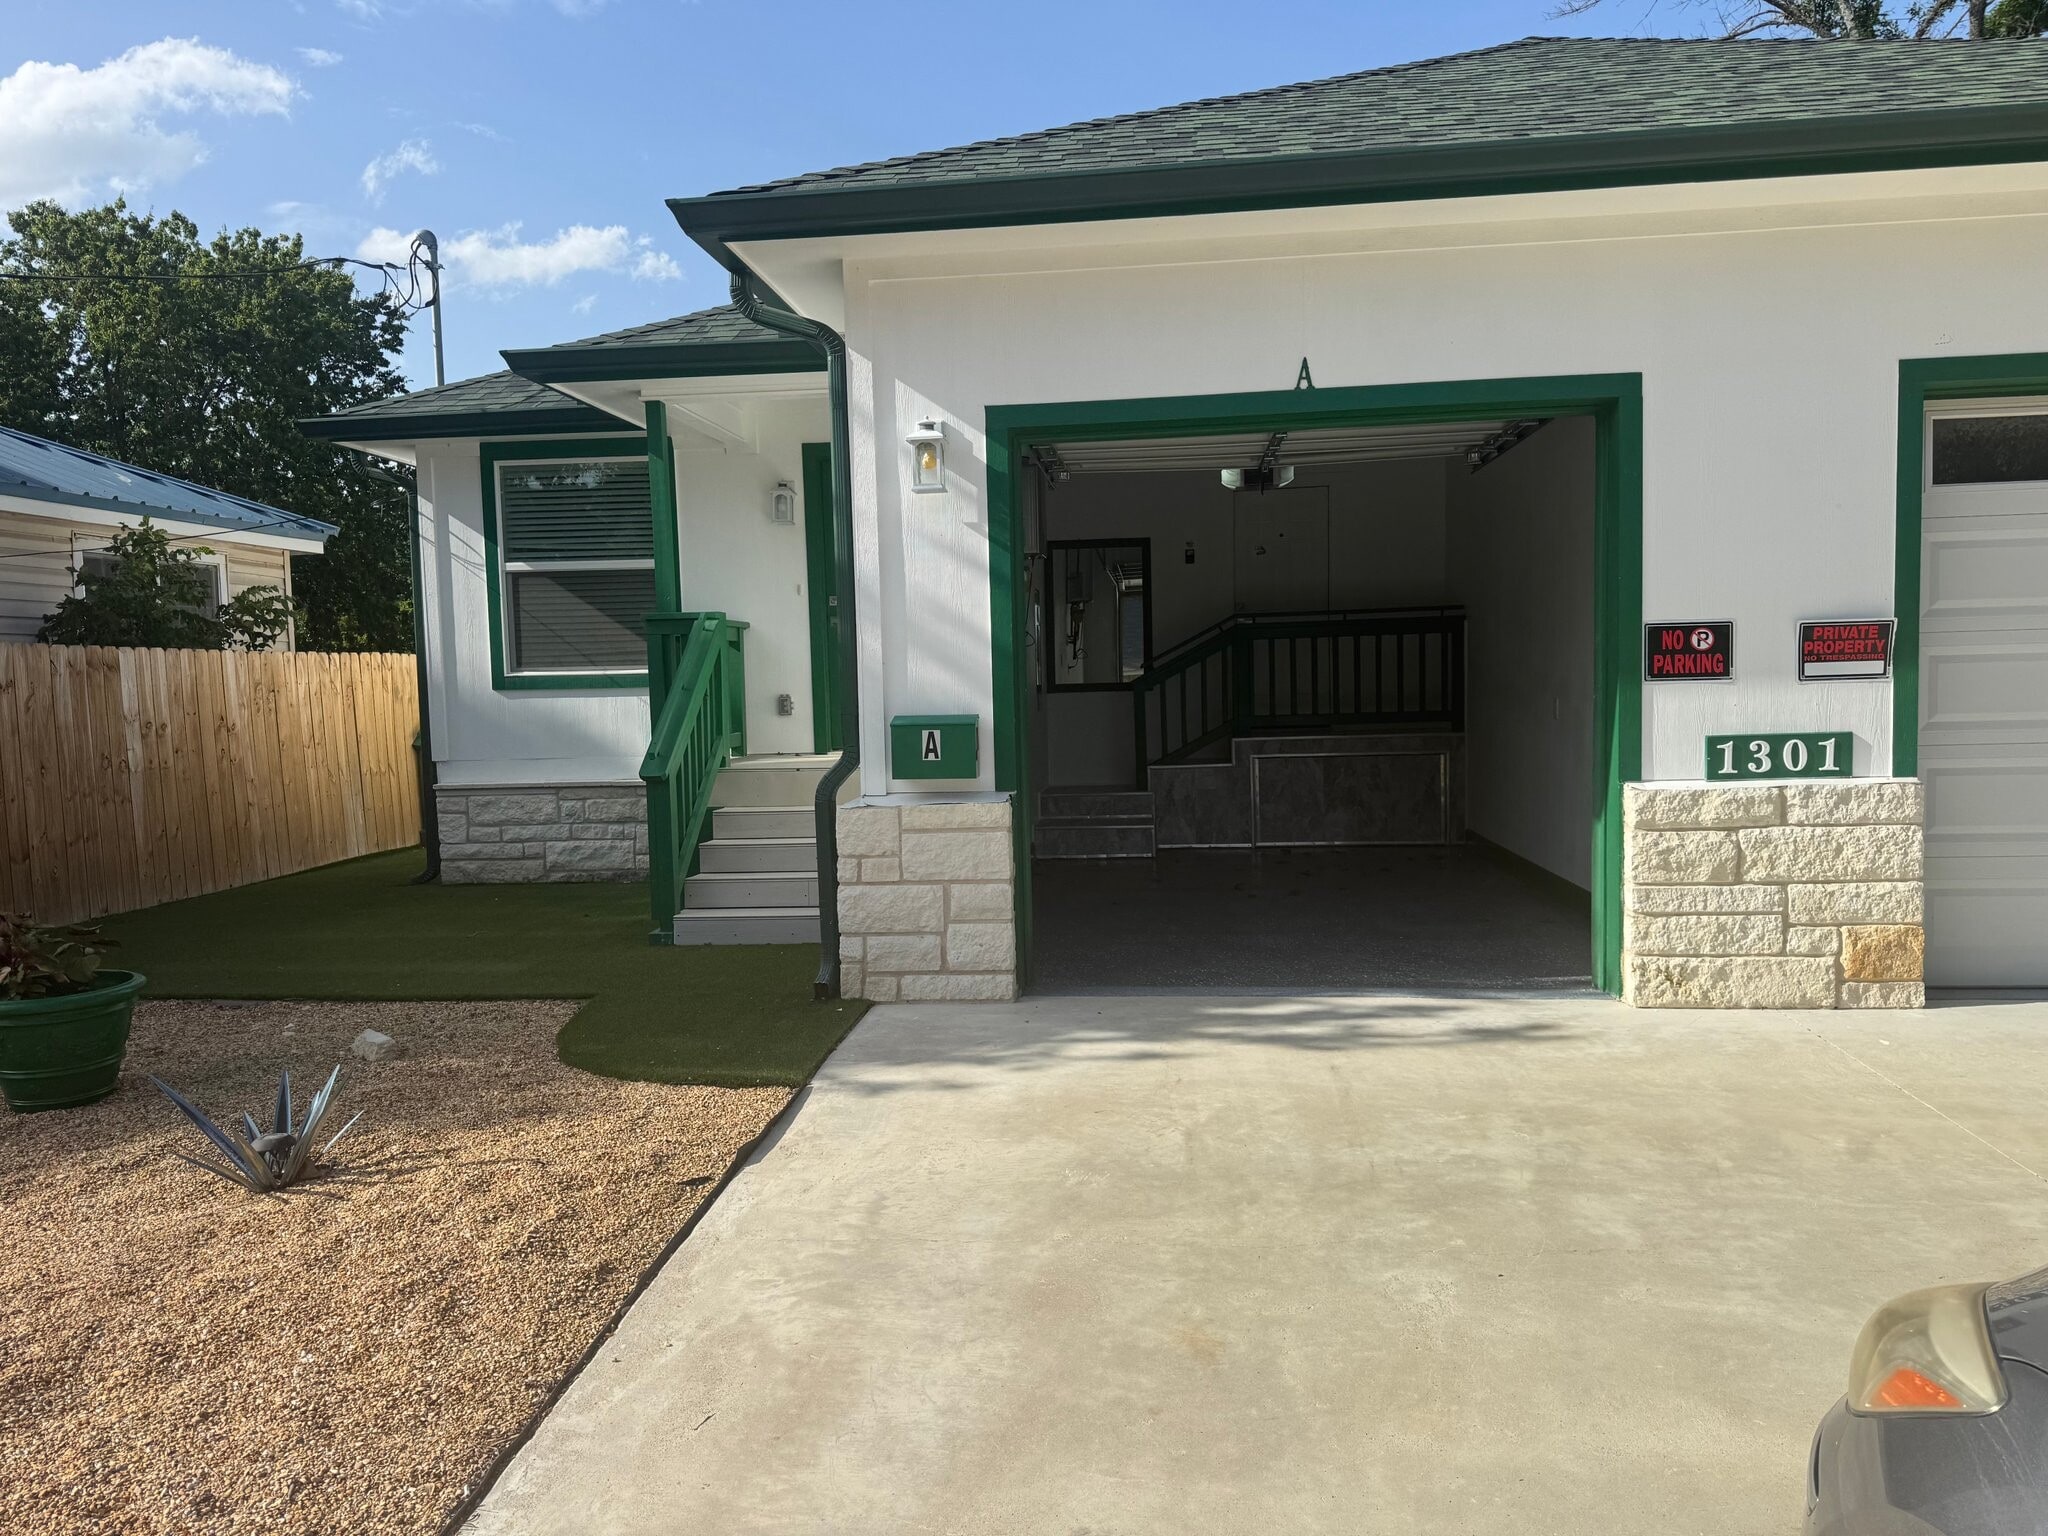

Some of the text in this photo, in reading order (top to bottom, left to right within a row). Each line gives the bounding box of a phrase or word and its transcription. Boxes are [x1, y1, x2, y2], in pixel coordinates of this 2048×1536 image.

[1294, 356, 1315, 391] A
[1661, 629, 1684, 650] NO
[1813, 625, 1879, 640] PRIVATE
[1804, 639, 1885, 654] PROPERTY
[1821, 653, 1885, 661] TRESPASSING
[1653, 653, 1724, 675] PARKING
[924, 731, 939, 759] A
[1716, 737, 1840, 774] 1301
